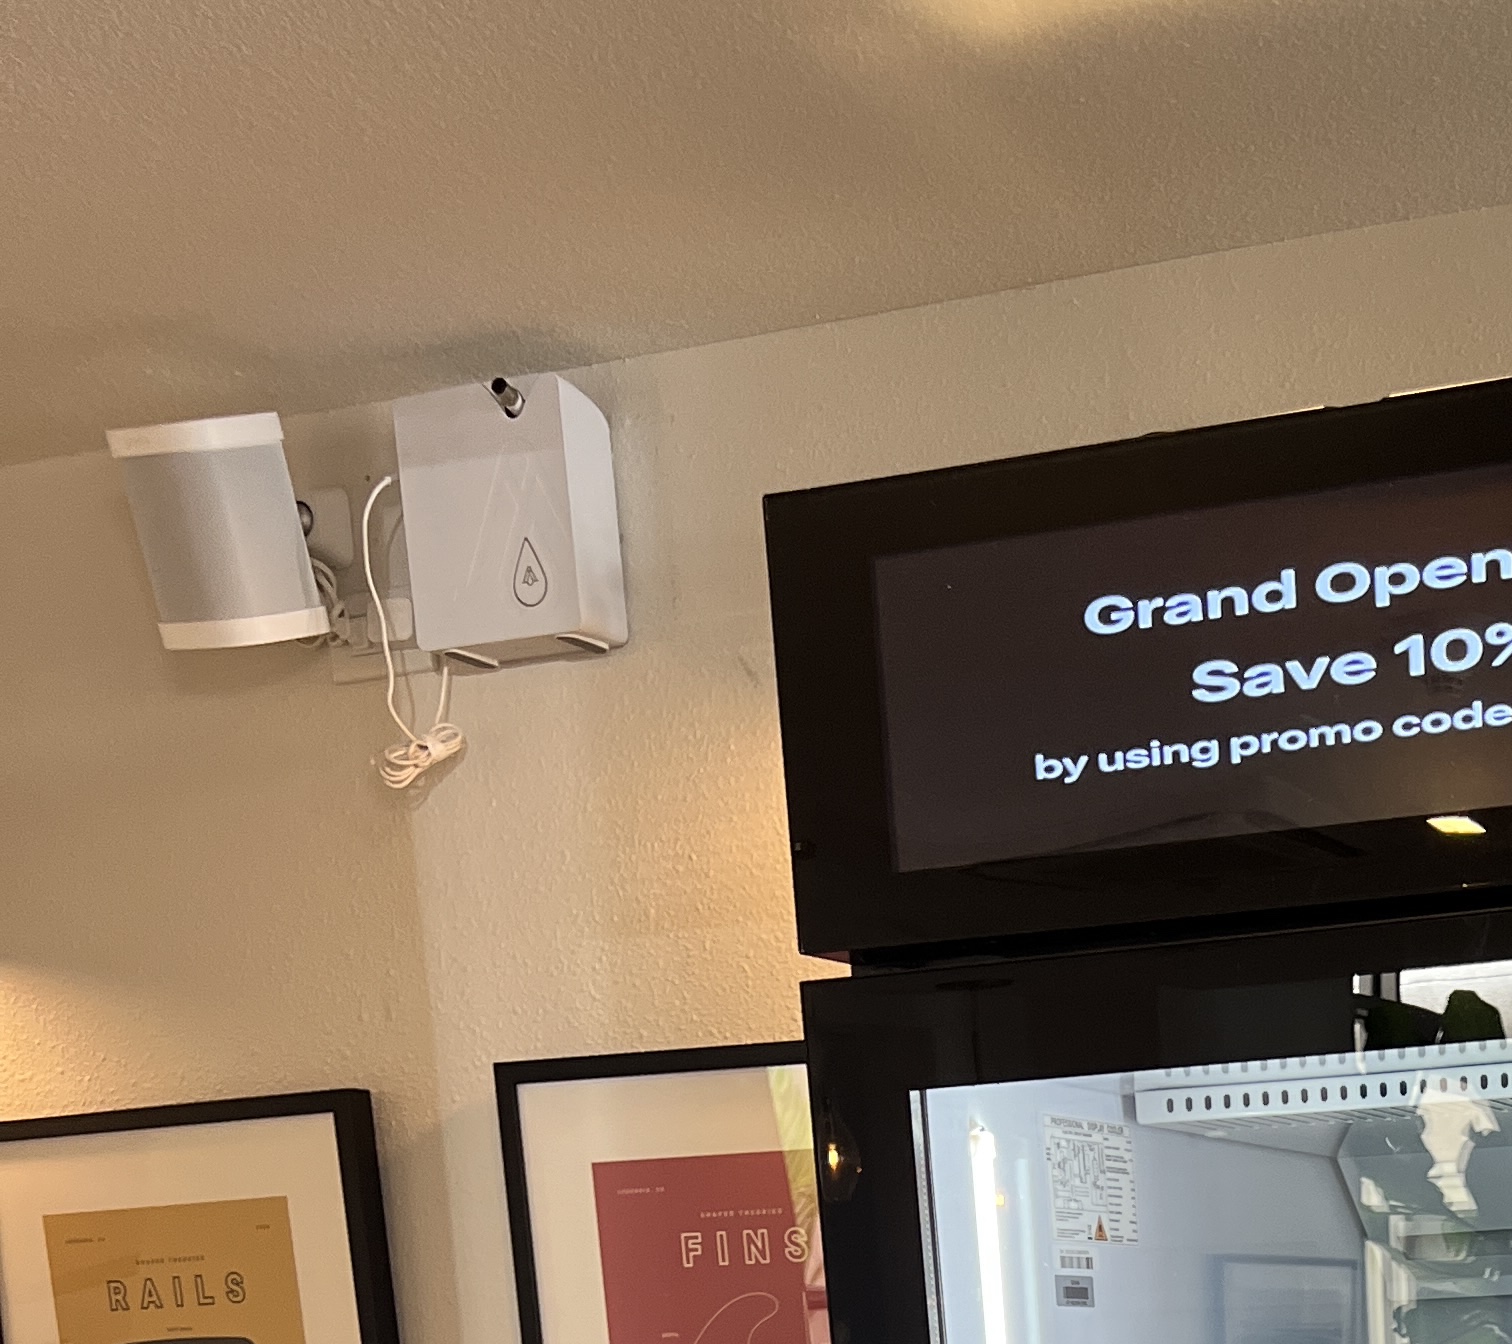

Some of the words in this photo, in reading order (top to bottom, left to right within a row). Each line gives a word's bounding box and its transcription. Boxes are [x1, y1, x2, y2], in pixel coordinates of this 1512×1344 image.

[1084, 569, 1297, 635] Grand
[1191, 652, 1378, 703] Save
[1034, 753, 1089, 784] by
[1098, 739, 1220, 769] using
[1229, 719, 1384, 766] promo
[1393, 700, 1512, 738] code
[680, 1226, 809, 1268] FINS
[106, 1271, 247, 1312] RAILS
